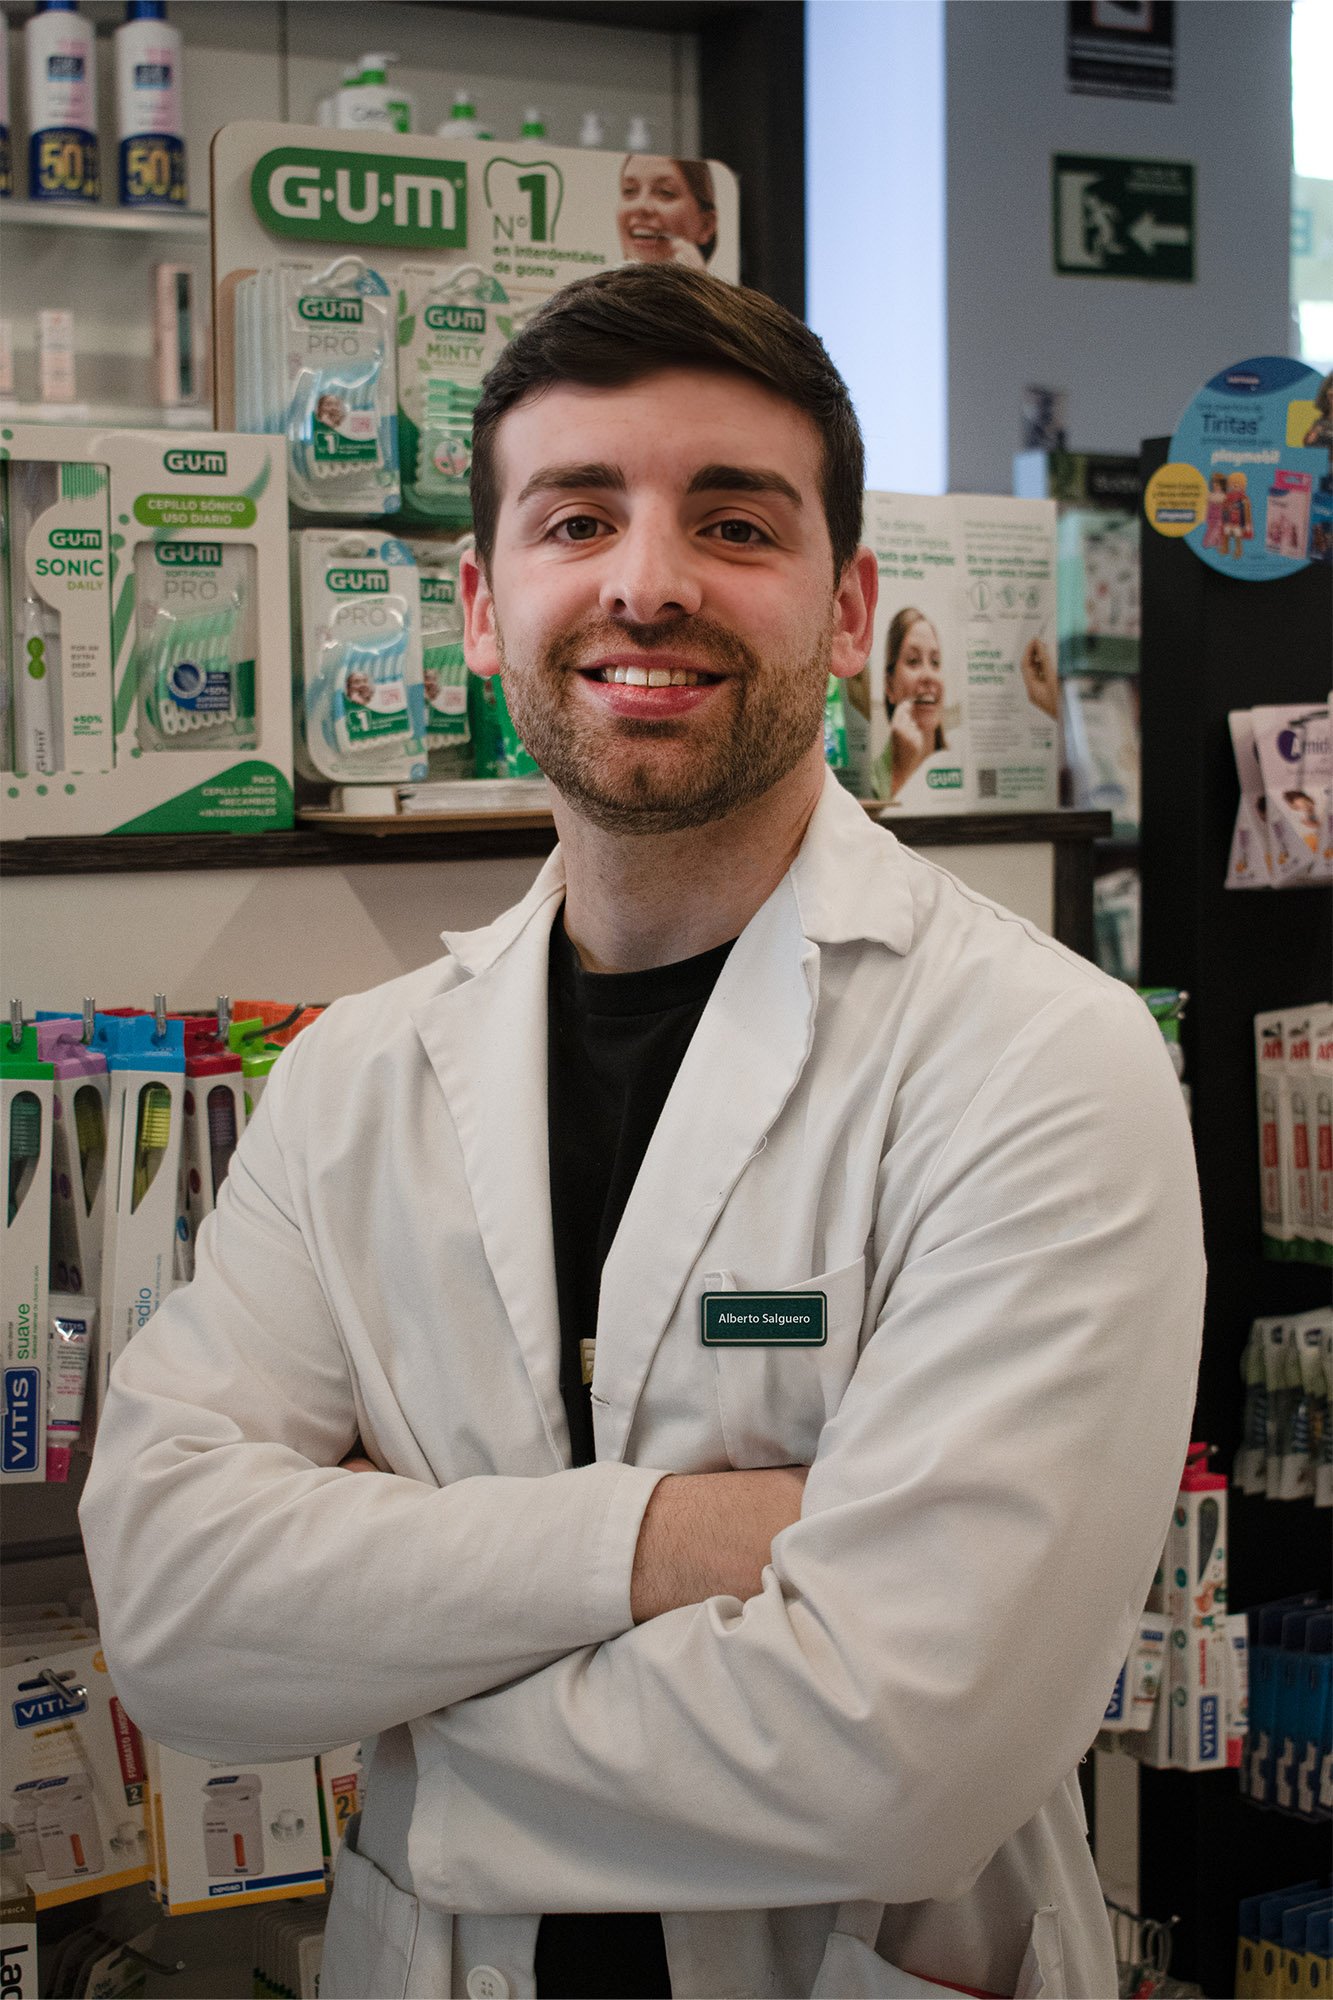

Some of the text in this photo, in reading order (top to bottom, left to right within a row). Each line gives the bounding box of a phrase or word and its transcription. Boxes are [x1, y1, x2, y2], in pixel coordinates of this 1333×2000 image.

[39, 142, 84, 191] 50
[126, 148, 172, 197] 50
[493, 261, 556, 278] de goma
[308, 335, 358, 355] PRO
[1202, 413, 1258, 435] Tiritas
[147, 499, 197, 511] CEPILLO
[161, 512, 232, 525] USO DIARIO
[35, 558, 104, 576] SONIC
[67, 580, 103, 591] DAILY
[164, 579, 219, 601] PRO
[336, 606, 387, 627] PRO
[135, 1287, 152, 1328] edio
[718, 1313, 811, 1326] Alberto Salguero
[17, 1303, 30, 1360] suave
[11, 1377, 29, 1463] VITIS
[1202, 1700, 1214, 1756] VITIS
[122, 1737, 137, 1779] FORMATO
[336, 1794, 350, 1820] 2
